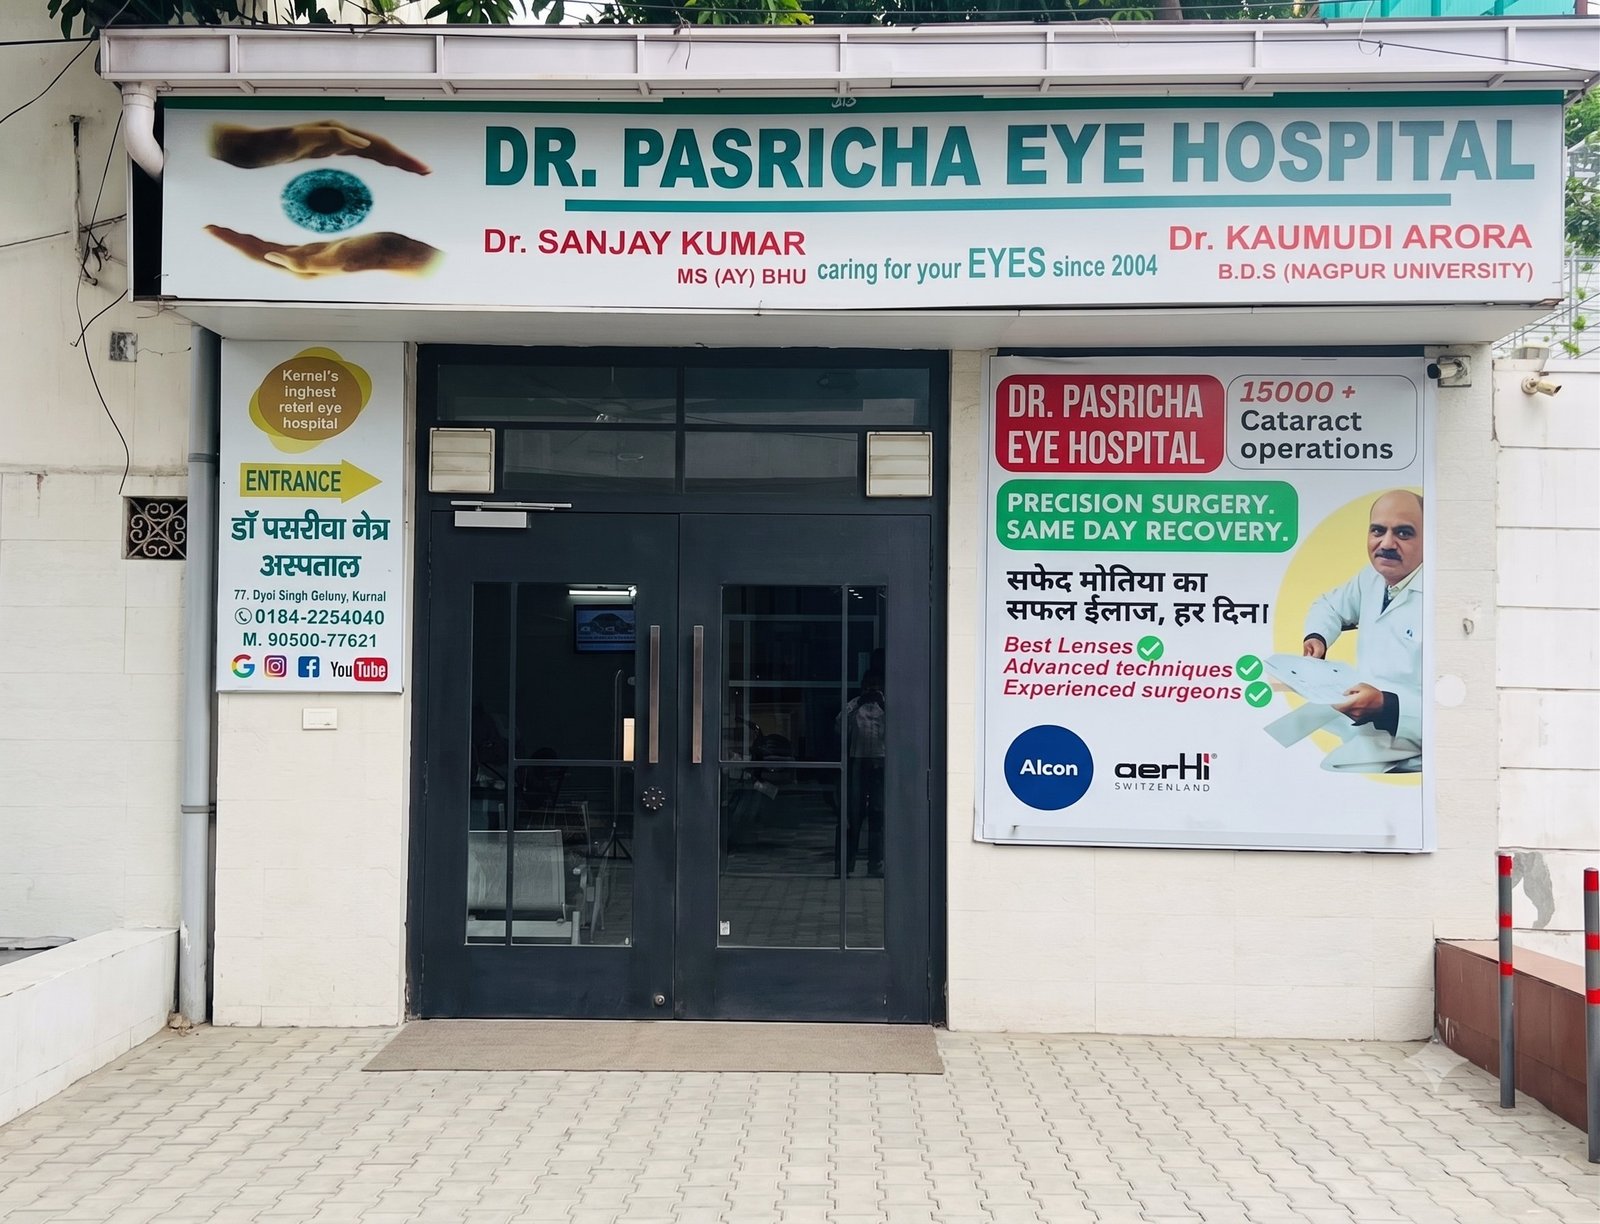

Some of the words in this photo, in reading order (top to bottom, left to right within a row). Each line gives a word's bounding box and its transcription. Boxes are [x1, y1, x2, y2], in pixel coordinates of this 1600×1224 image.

[486, 126, 596, 186] DR.
[624, 126, 980, 188] PASRICHA
[1007, 123, 1144, 184] EYE
[1172, 119, 1535, 182] HOSPITAL
[485, 229, 526, 253] Dr.
[539, 230, 671, 254] SANJAY
[682, 231, 805, 255] KUMAR
[1170, 226, 1213, 250] Dr.
[1227, 225, 1391, 250] KAUMUDI
[1402, 224, 1532, 248] ARORA
[818, 258, 877, 284] caring
[884, 258, 911, 279] for
[917, 263, 961, 284] your
[969, 247, 1045, 278] EYES
[1053, 256, 1104, 277] since
[1112, 254, 1157, 276] 2004
[1219, 264, 1275, 279] B.D.S
[1284, 263, 1385, 283] (NAGPUR
[1394, 263, 1533, 282] UNIVERSITY)
[678, 269, 707, 284] MS
[715, 269, 754, 288] (AY)
[763, 269, 805, 284] BHU
[283, 370, 338, 381] Kernel's
[1009, 385, 1052, 417] DR.
[1064, 385, 1203, 418] PASRICHA
[1240, 381, 1333, 402] 15000
[318, 405, 341, 415] eye
[1241, 410, 1361, 431] Cataract
[284, 417, 337, 431] hospital
[1009, 431, 1059, 463] EYE
[1069, 431, 1204, 464] HOSPITAL
[1241, 437, 1393, 464] operations
[247, 470, 341, 491] ENTRANCE
[1009, 493, 1142, 513] PRECISION
[1152, 494, 1274, 514] SURGERY.
[231, 510, 259, 540] डॉ
[352, 510, 390, 540] नेत्र
[1007, 520, 1074, 539] SAME
[1085, 521, 1137, 540] DAY
[1147, 520, 1288, 541] RECOVERY.
[260, 555, 362, 578] अस्पताल
[1007, 563, 1073, 592] सफेद
[1080, 564, 1166, 592] मोतिया
[1173, 573, 1208, 592] का
[279, 590, 307, 603] Singh
[353, 591, 385, 601] Kurnal
[256, 609, 384, 624] 0184-2254040
[1006, 601, 1077, 620] सफल
[1084, 594, 1164, 625] ईलाज,
[1174, 603, 1205, 627] हर
[244, 633, 261, 646] M.
[269, 633, 375, 647] 90500-77621
[1005, 637, 1051, 653] Best
[1058, 637, 1133, 654] Lenses
[1003, 658, 1109, 675] Advanced
[1117, 659, 1232, 680] techniques
[1004, 679, 1135, 699] Experienced
[1142, 686, 1241, 702] surgeons
[1020, 760, 1077, 775] Alcon
